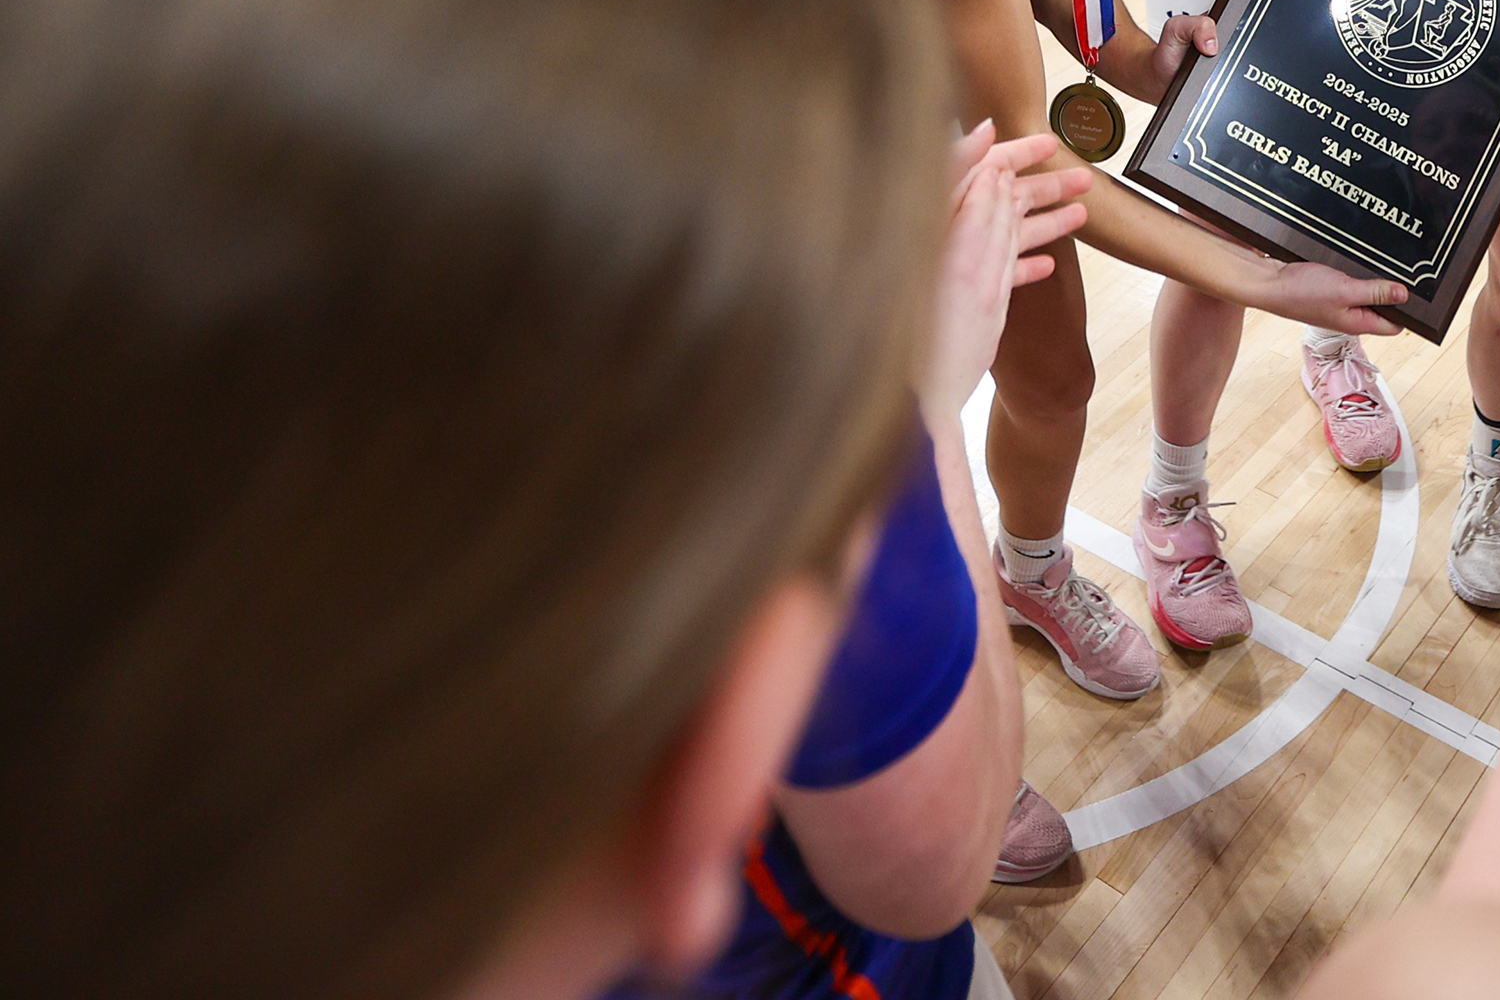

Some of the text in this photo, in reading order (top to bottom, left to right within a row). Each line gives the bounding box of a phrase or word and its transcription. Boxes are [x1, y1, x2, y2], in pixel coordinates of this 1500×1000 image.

[1323, 73, 1411, 127] 2024-2025
[1405, 39, 1481, 85] ASSOCIATION
[1244, 64, 1461, 191] DISTRICT II CHAMPIONS
[1226, 120, 1424, 239] GIRLS BASKETBALL
